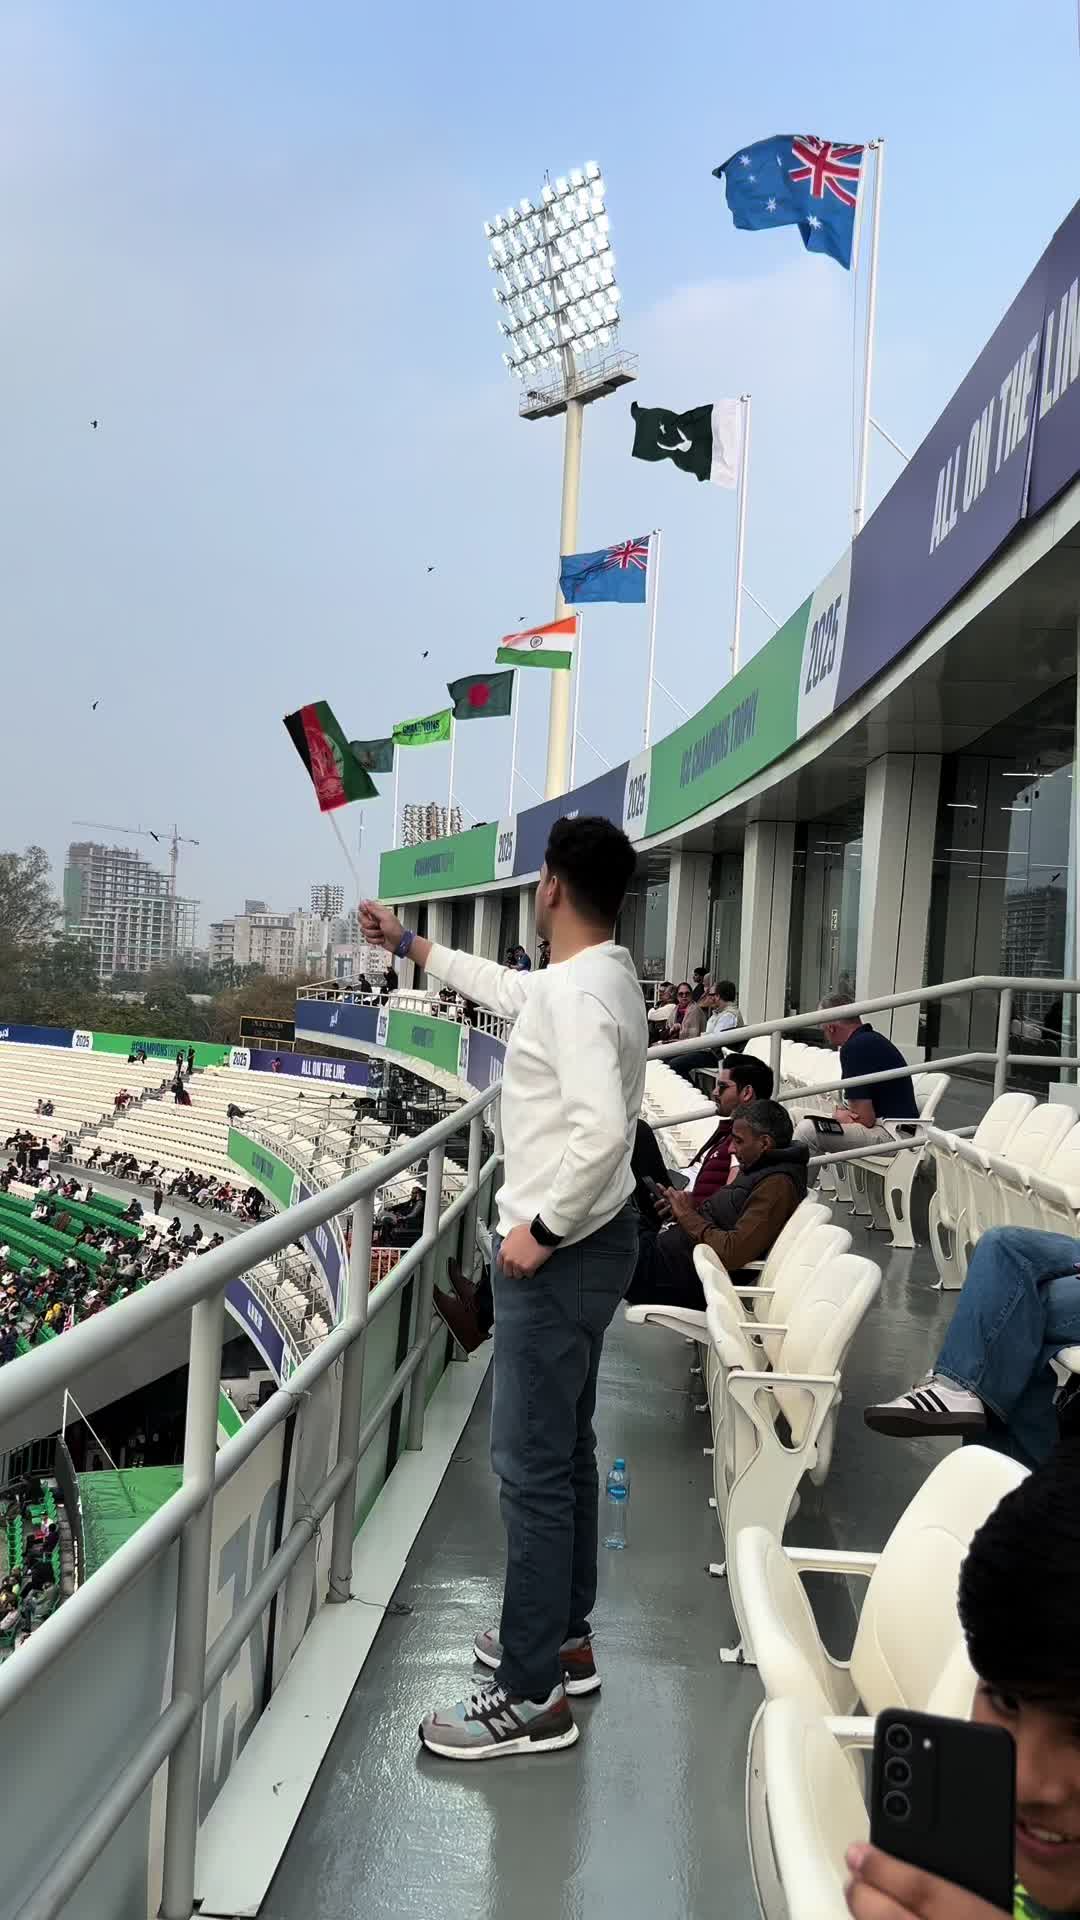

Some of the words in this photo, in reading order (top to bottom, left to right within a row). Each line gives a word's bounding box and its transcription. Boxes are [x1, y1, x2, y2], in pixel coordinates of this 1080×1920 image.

[929, 445, 960, 555] ALL
[963, 396, 995, 513] ON
[995, 331, 1039, 475] THE
[1039, 277, 1080, 421] LIN
[805, 593, 842, 695] 2025
[627, 772, 647, 820] 2025
[498, 832, 513, 863] 2025
[76, 1034, 90, 1048] 2025
[233, 1052, 248, 1067] 2025
[301, 1060, 311, 1075] ALL
[312, 1061, 321, 1077] ON
[321, 1062, 333, 1078] THE
[333, 1064, 346, 1080] LINE
